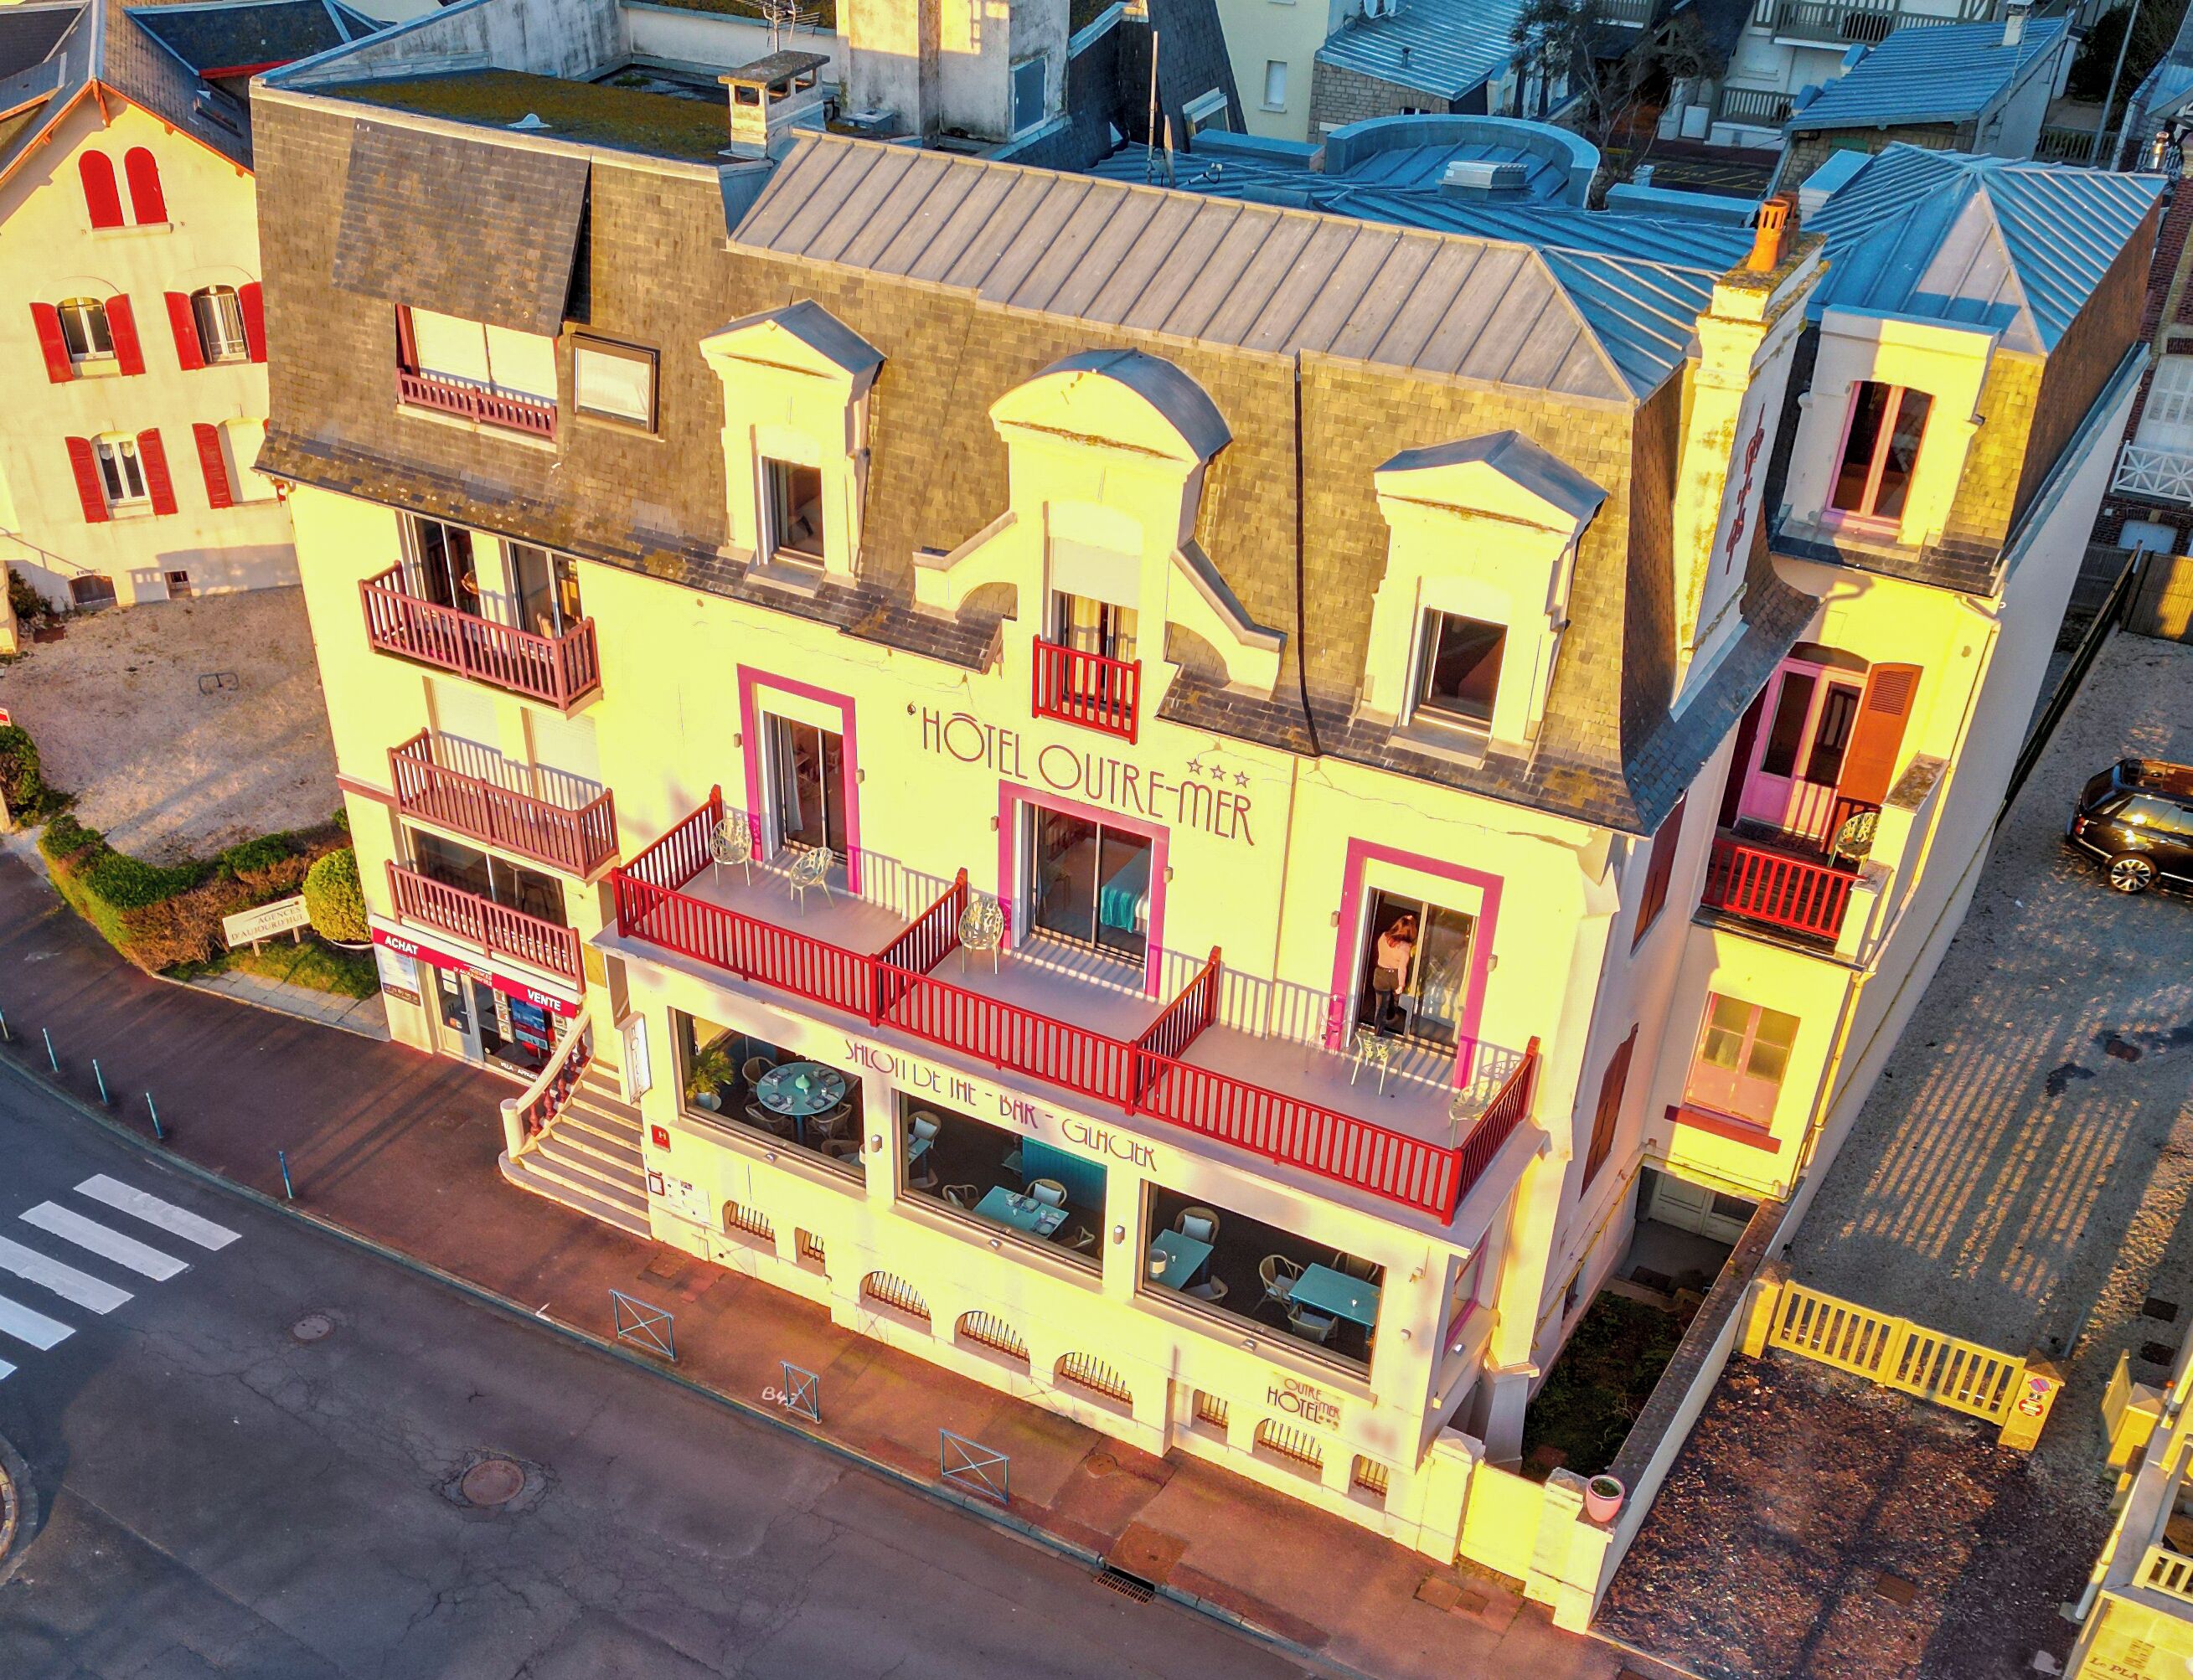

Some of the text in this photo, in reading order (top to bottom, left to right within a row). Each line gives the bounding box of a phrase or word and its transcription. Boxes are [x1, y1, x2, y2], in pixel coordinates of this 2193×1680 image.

[922, 707, 1255, 847] HÔTEL OUTRE-MER
[258, 907, 302, 924] AGENCES
[231, 914, 303, 940] D'AUJOURD'HUI
[384, 935, 419, 955] ACHAT
[527, 989, 561, 1011] VENTE
[913, 1063, 942, 1093] DE
[999, 1094, 1039, 1129] BAR
[658, 1131, 667, 1140] H
[1284, 1378, 1322, 1401] OUTRE
